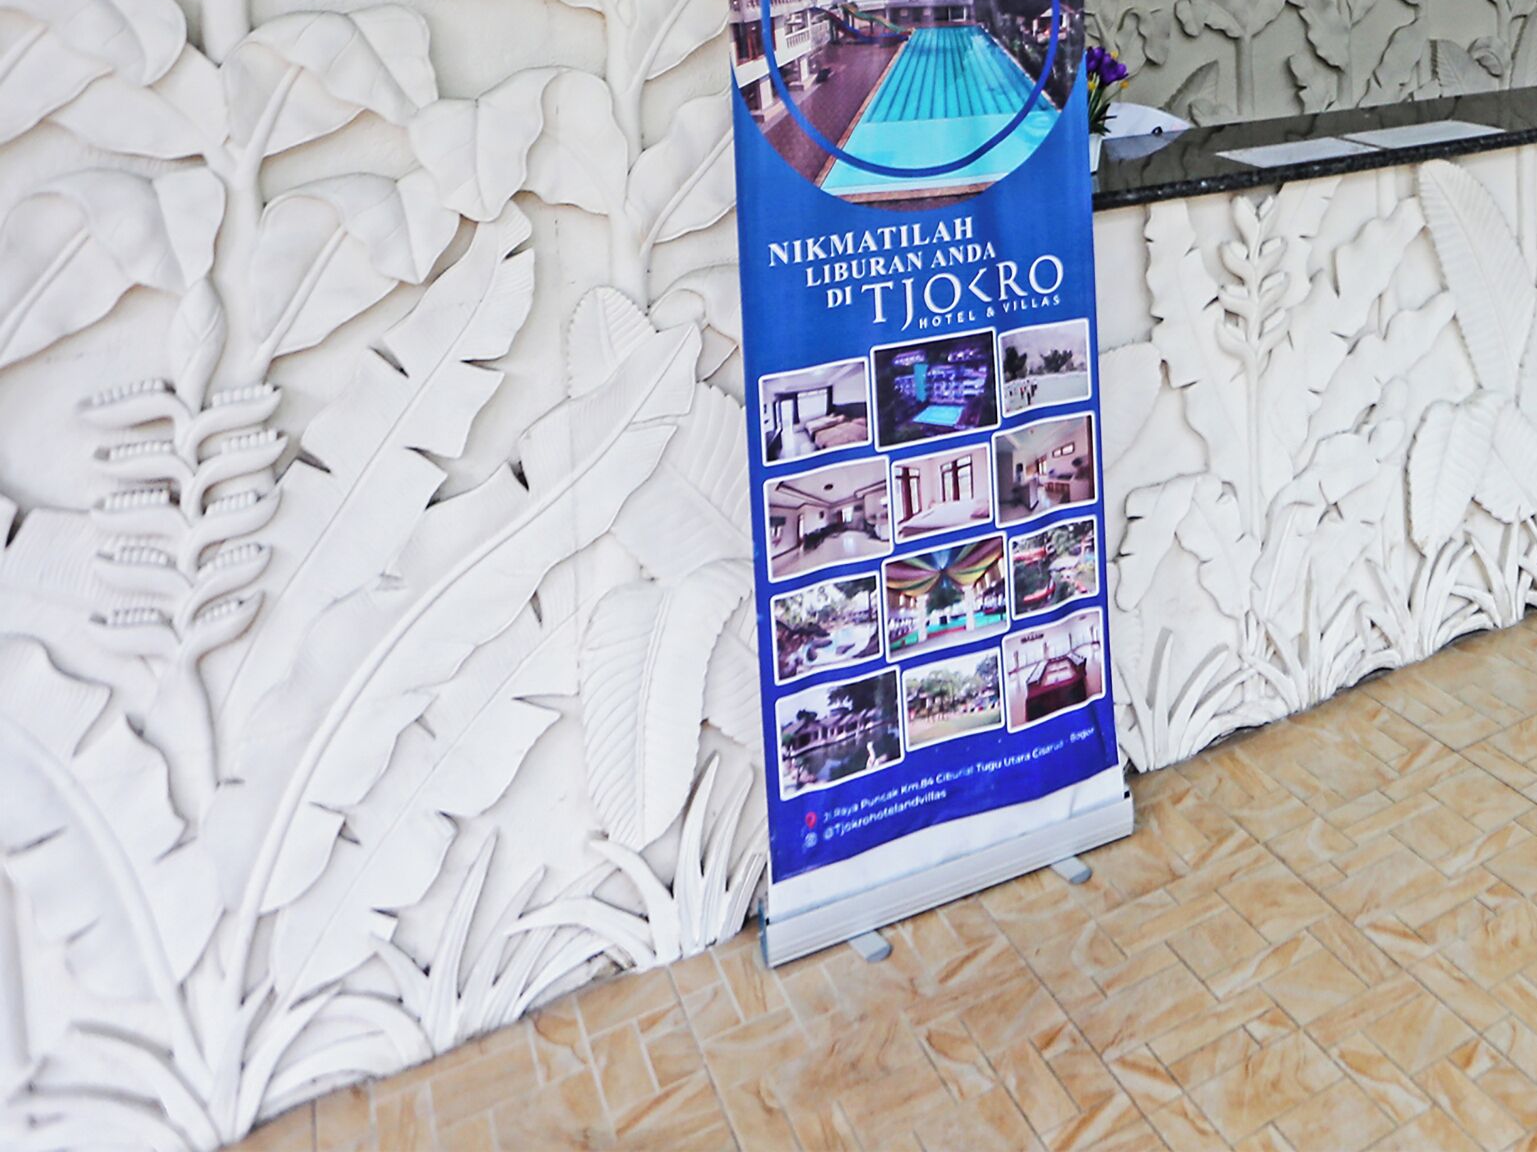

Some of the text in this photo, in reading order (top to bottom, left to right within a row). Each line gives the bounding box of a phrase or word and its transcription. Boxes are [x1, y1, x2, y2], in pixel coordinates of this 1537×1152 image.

[768, 215, 974, 267] NIKMATILAH
[805, 241, 997, 288] LIBURAN ANDA
[826, 287, 852, 309] DI
[919, 295, 1062, 329] HOTEL & VILLAS
[976, 760, 1002, 773] Tugu
[1003, 752, 1031, 768] Utara
